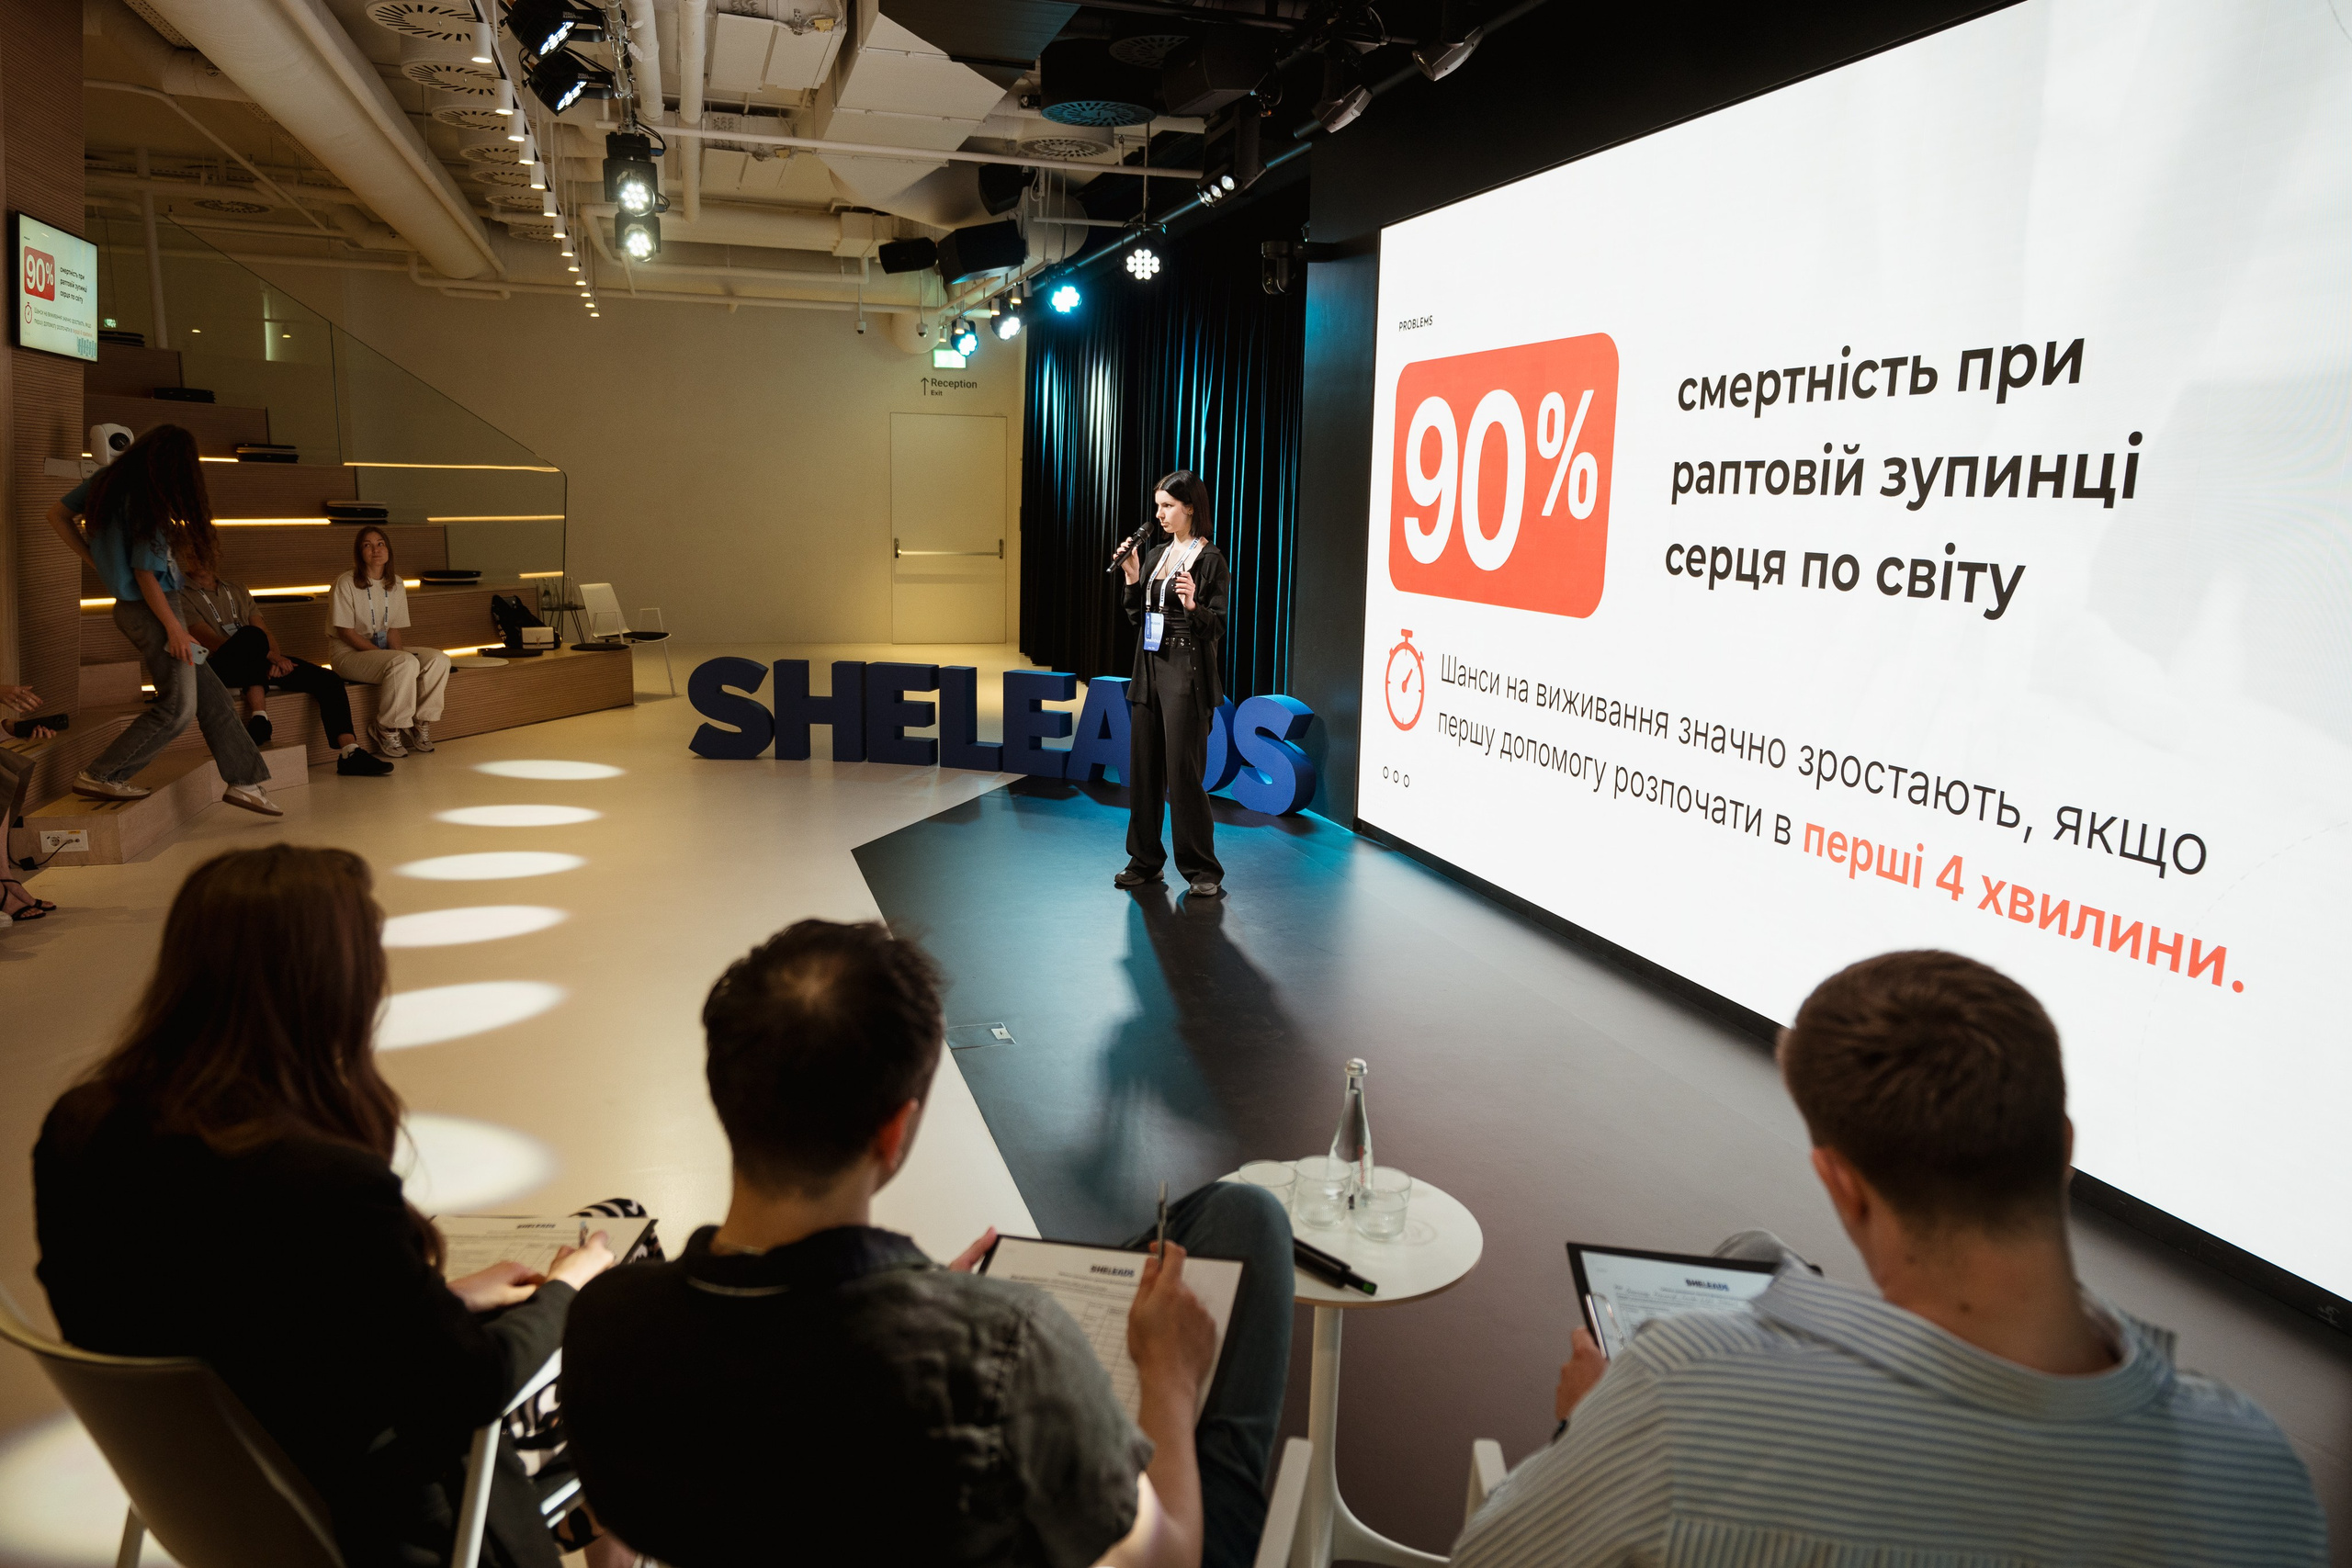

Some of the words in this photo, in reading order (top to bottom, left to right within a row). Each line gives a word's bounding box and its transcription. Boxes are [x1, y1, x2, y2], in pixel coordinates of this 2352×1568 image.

[27, 254, 54, 292] 90%
[1398, 315, 1433, 332] PROBLEMS
[931, 378, 978, 389] Reception
[1678, 344, 1939, 419] смертність
[1957, 337, 2085, 405] при
[1404, 389, 1599, 571] 90%
[1671, 442, 1865, 505] раптовій
[1879, 431, 2143, 512] зупинці
[1665, 542, 1786, 591] серця
[1801, 551, 1860, 592] по
[1876, 542, 2027, 621] світу
[1440, 653, 1500, 696] Шанси
[1506, 675, 1529, 704] на
[1536, 682, 1669, 740] виживання
[1678, 716, 1786, 769] значно
[1798, 745, 2033, 844] зростають,
[2052, 806, 2207, 879] якщо
[1438, 711, 1496, 757] першу
[1499, 731, 1608, 793] допомогу
[1613, 764, 1763, 838] розпочати
[1774, 813, 1792, 845] в
[1804, 822, 1925, 889] перші
[1935, 854, 1964, 901] 4
[1977, 874, 2245, 994] хвилини.
